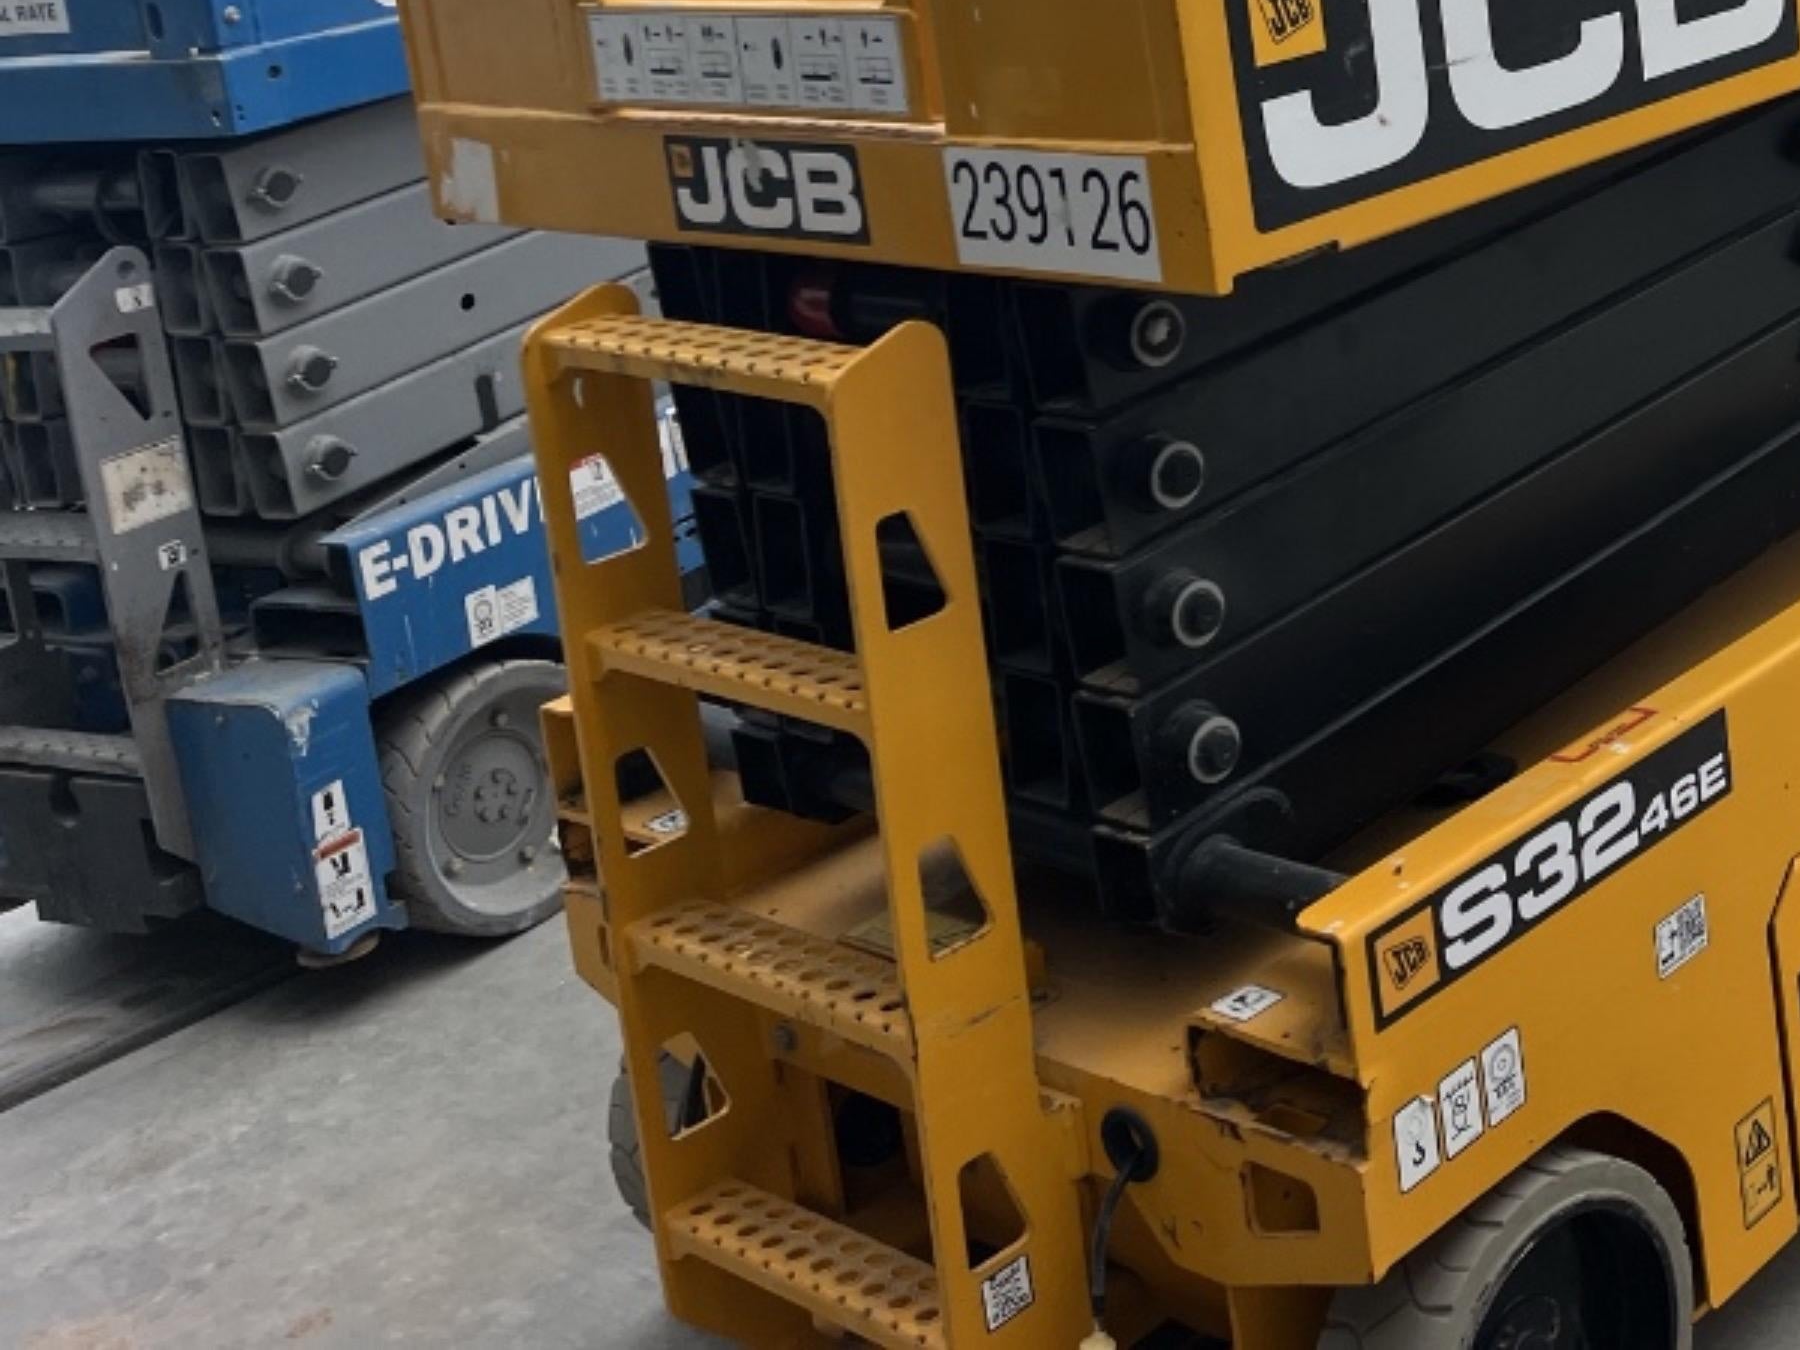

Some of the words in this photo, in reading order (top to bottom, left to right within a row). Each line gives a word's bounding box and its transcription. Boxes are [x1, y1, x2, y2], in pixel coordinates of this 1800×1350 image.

[677, 146, 863, 235] JCB
[953, 159, 1152, 256] 239126
[1391, 941, 1427, 983] JCB
